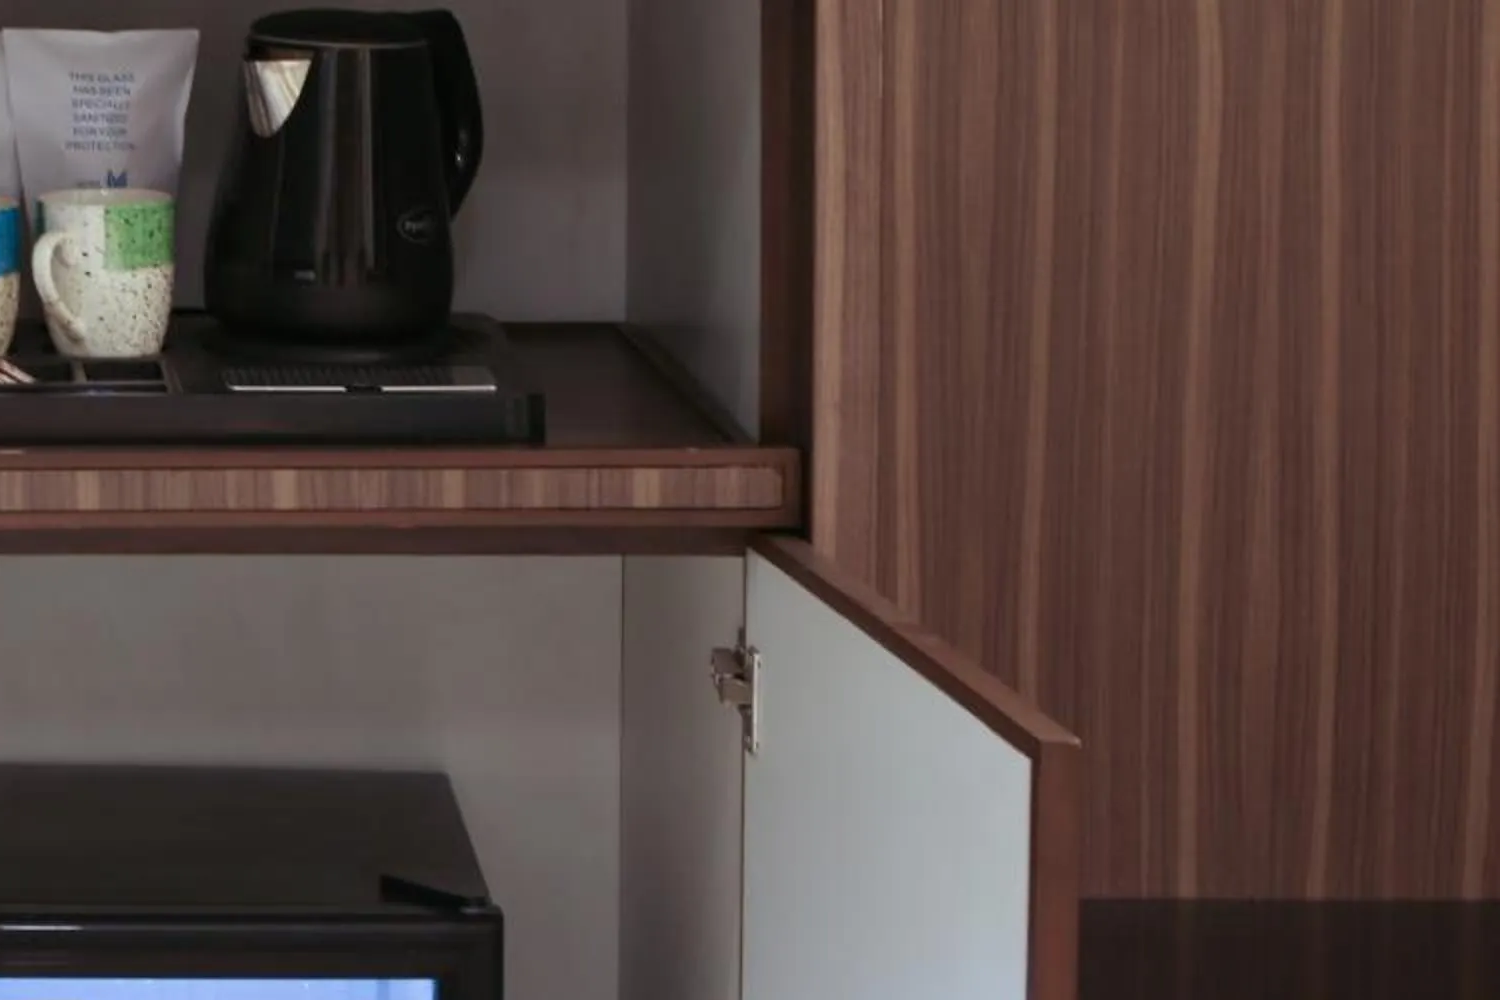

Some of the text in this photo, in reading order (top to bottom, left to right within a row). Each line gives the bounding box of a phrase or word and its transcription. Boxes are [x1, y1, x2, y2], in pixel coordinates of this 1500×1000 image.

[68, 72, 135, 83] THIS GLASS
[73, 85, 131, 97] HAS BEEN
[72, 99, 130, 110] SPECIALLY
[73, 127, 128, 138] FOR YOUR
[65, 141, 137, 152] PROTECTION
